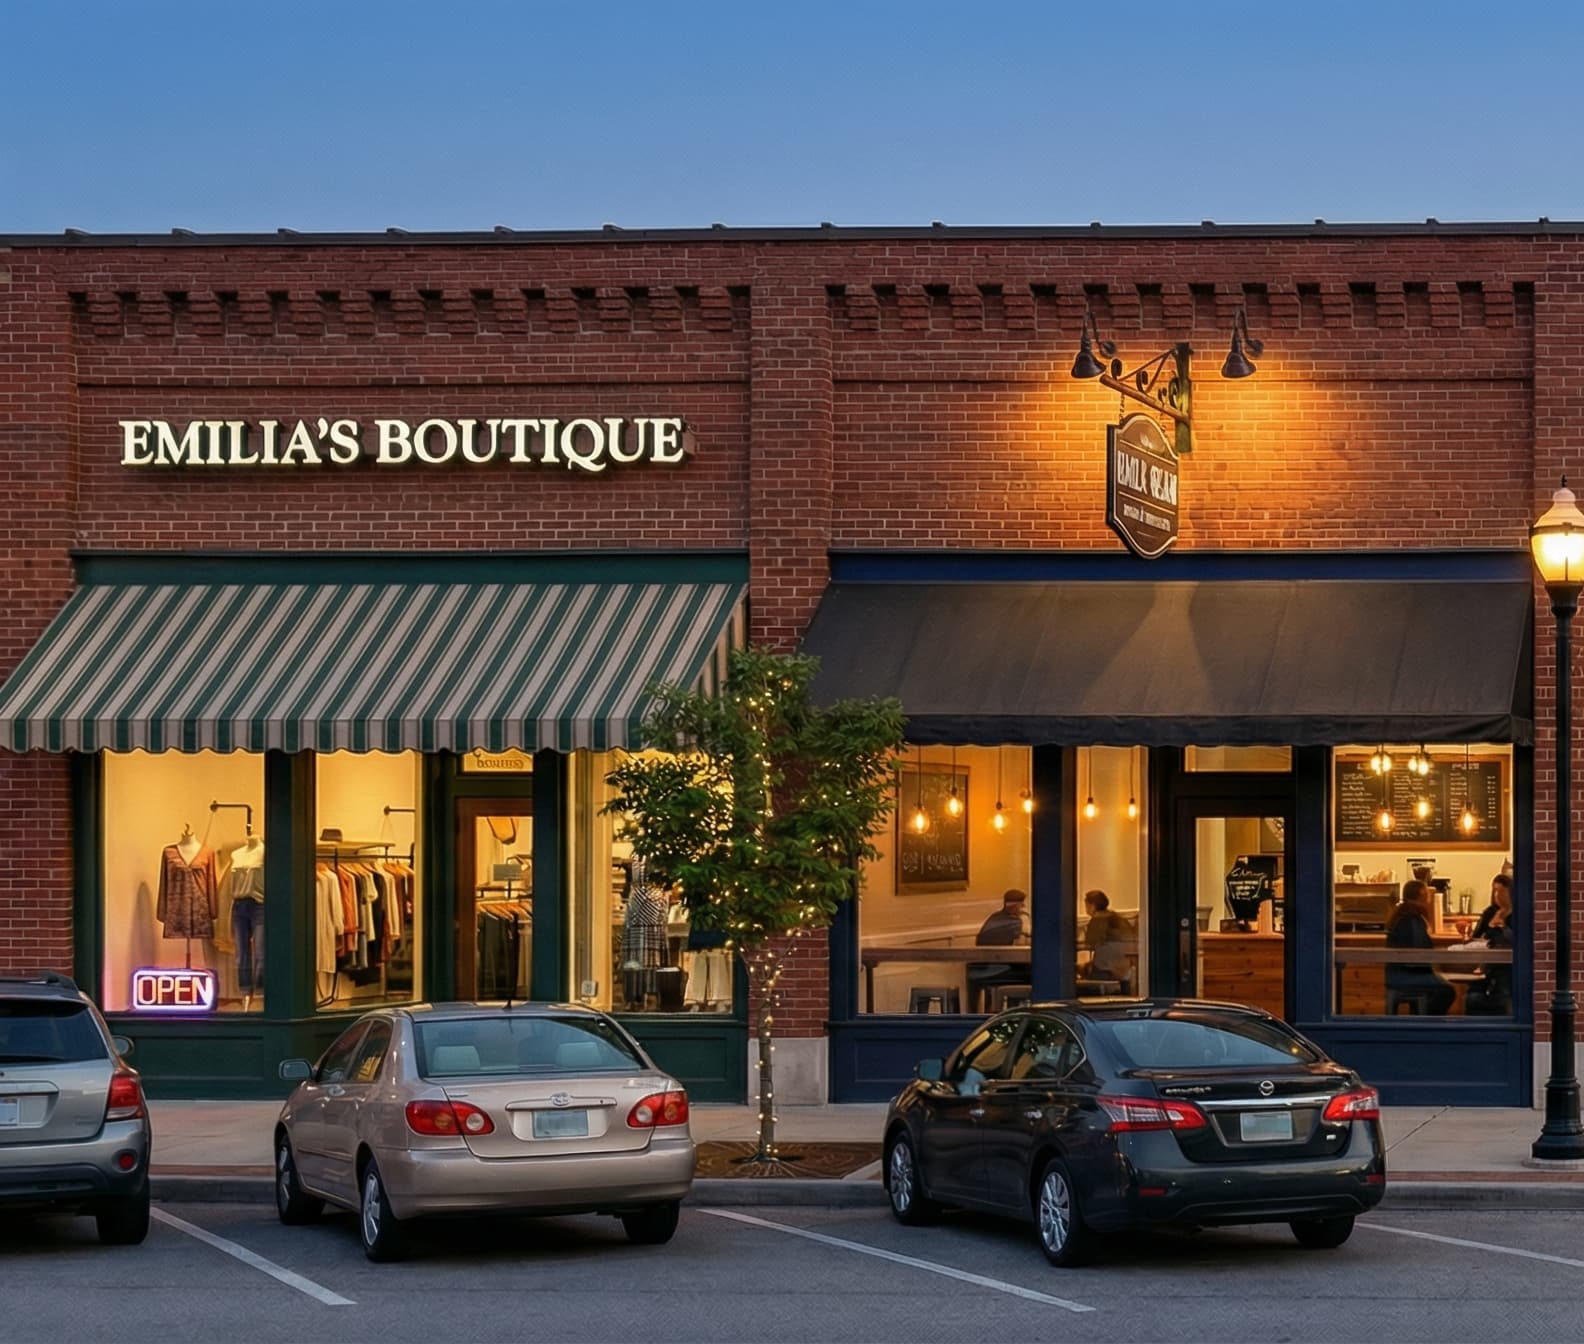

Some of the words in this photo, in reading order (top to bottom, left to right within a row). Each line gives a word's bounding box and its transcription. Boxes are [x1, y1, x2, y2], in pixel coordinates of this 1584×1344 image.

[118, 417, 358, 465] EMILIA'S
[374, 417, 683, 472] BOUTIQUE
[138, 975, 213, 1006] OPEN
